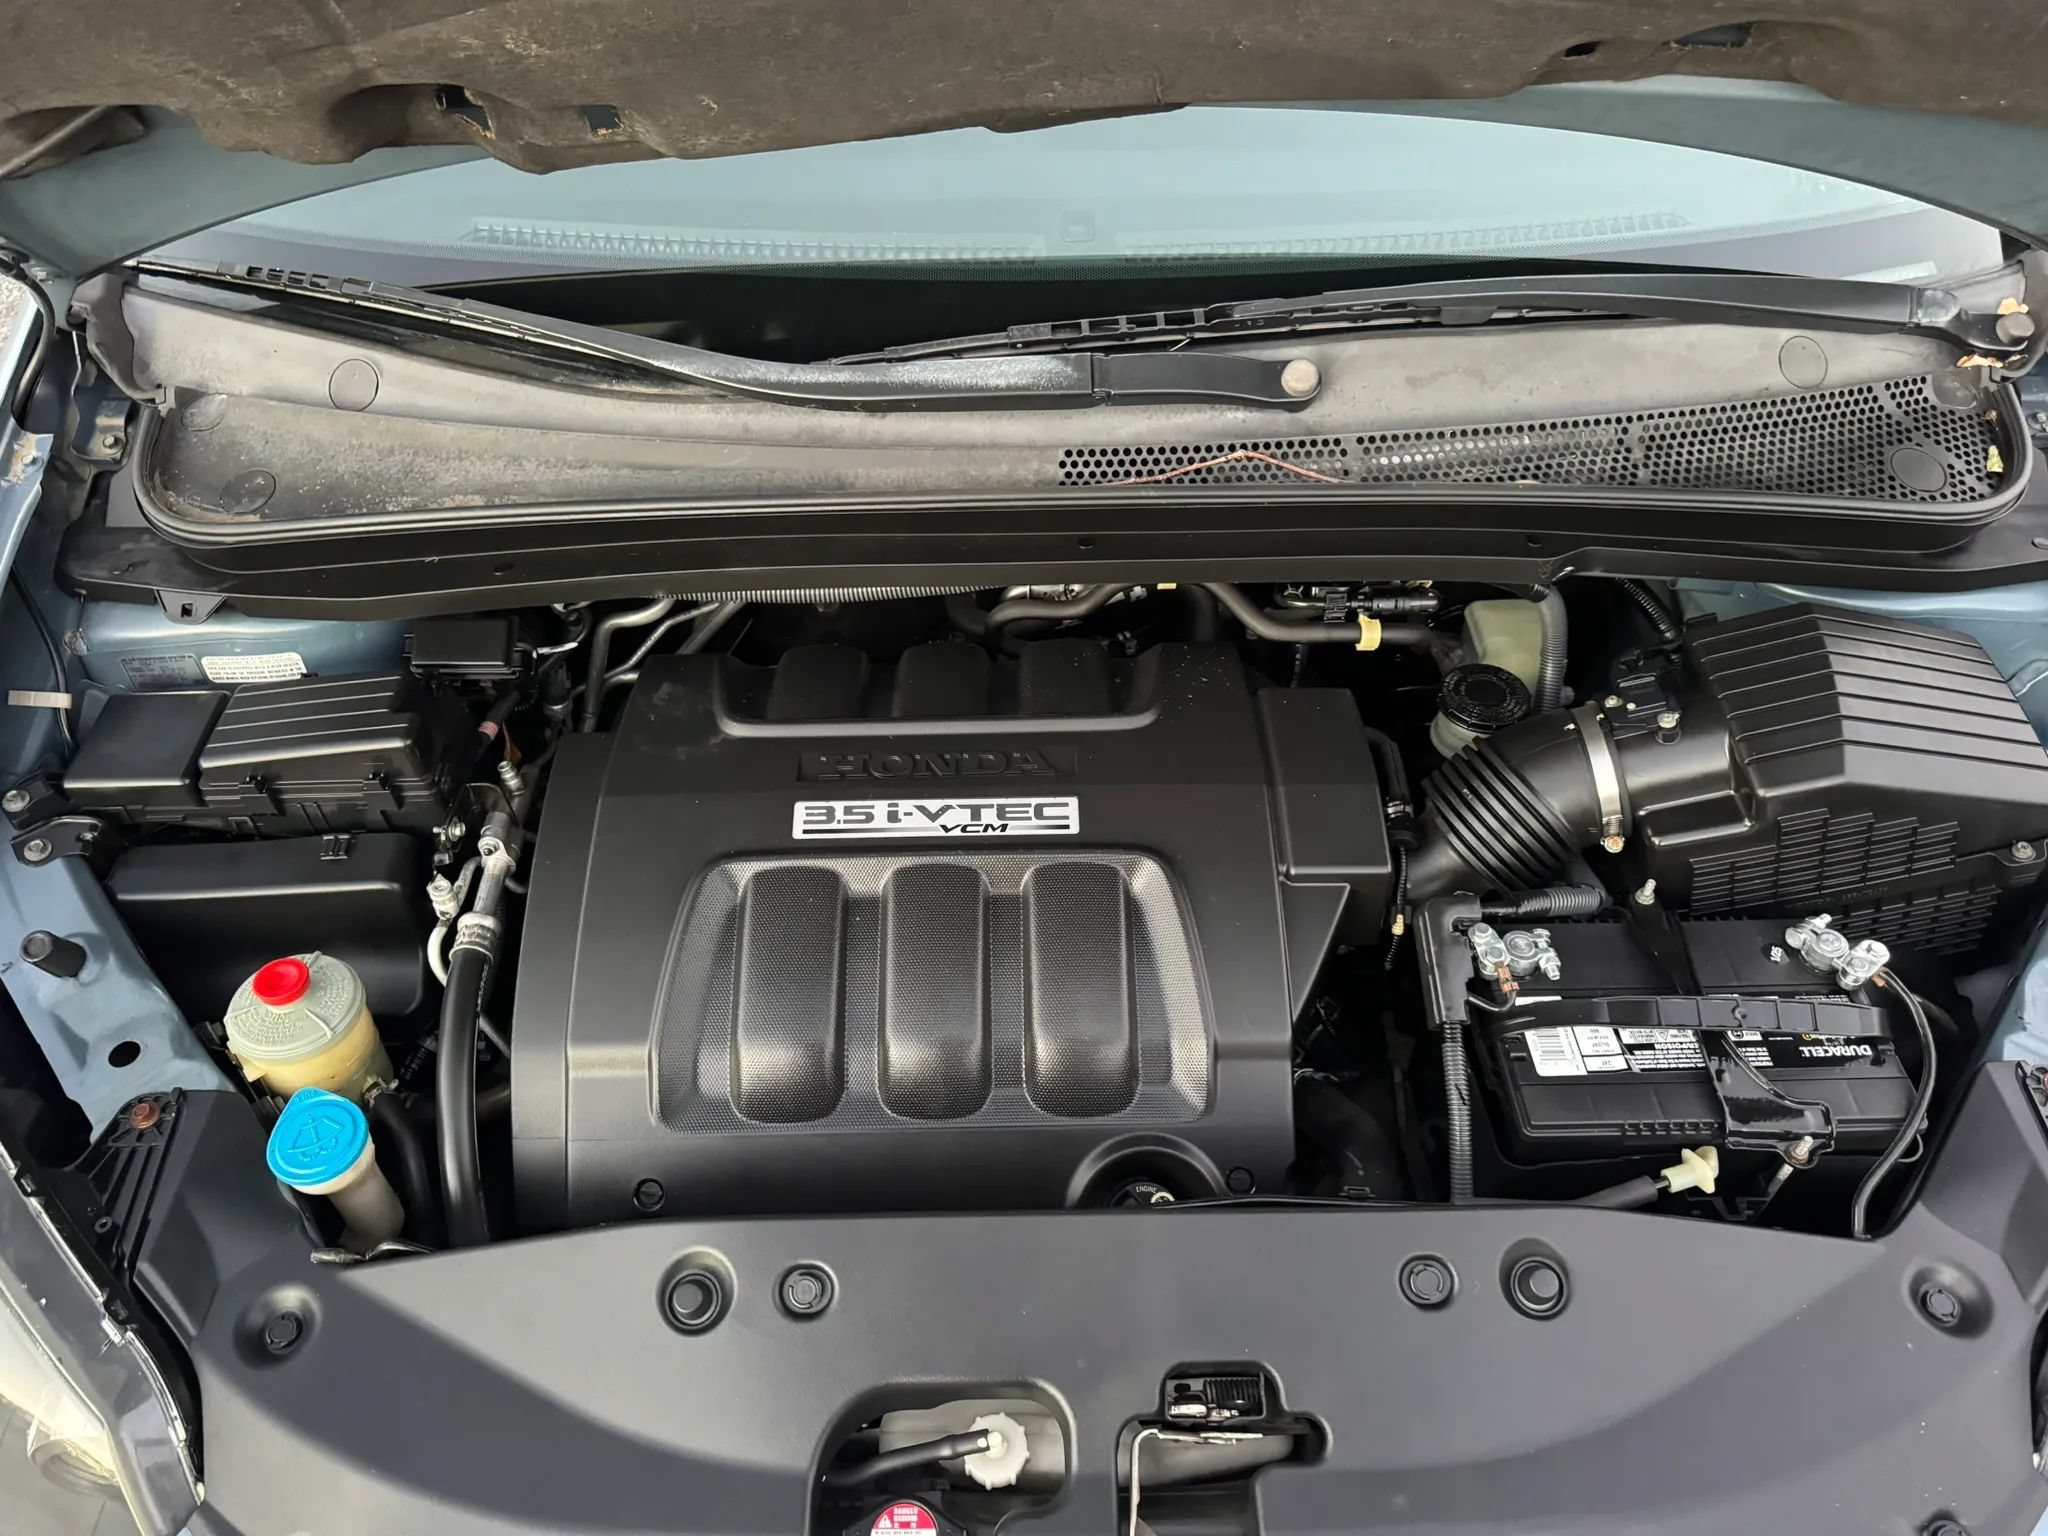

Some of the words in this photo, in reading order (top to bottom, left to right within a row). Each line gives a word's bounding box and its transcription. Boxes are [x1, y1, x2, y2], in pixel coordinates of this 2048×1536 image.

[818, 752, 1058, 778] HONDA
[802, 804, 876, 826] 3.5
[886, 801, 1071, 824] i-VTEC
[938, 823, 1010, 834] VCM
[1798, 1045, 1873, 1058] DURACELL
[1135, 1185, 1158, 1194] ENGINE
